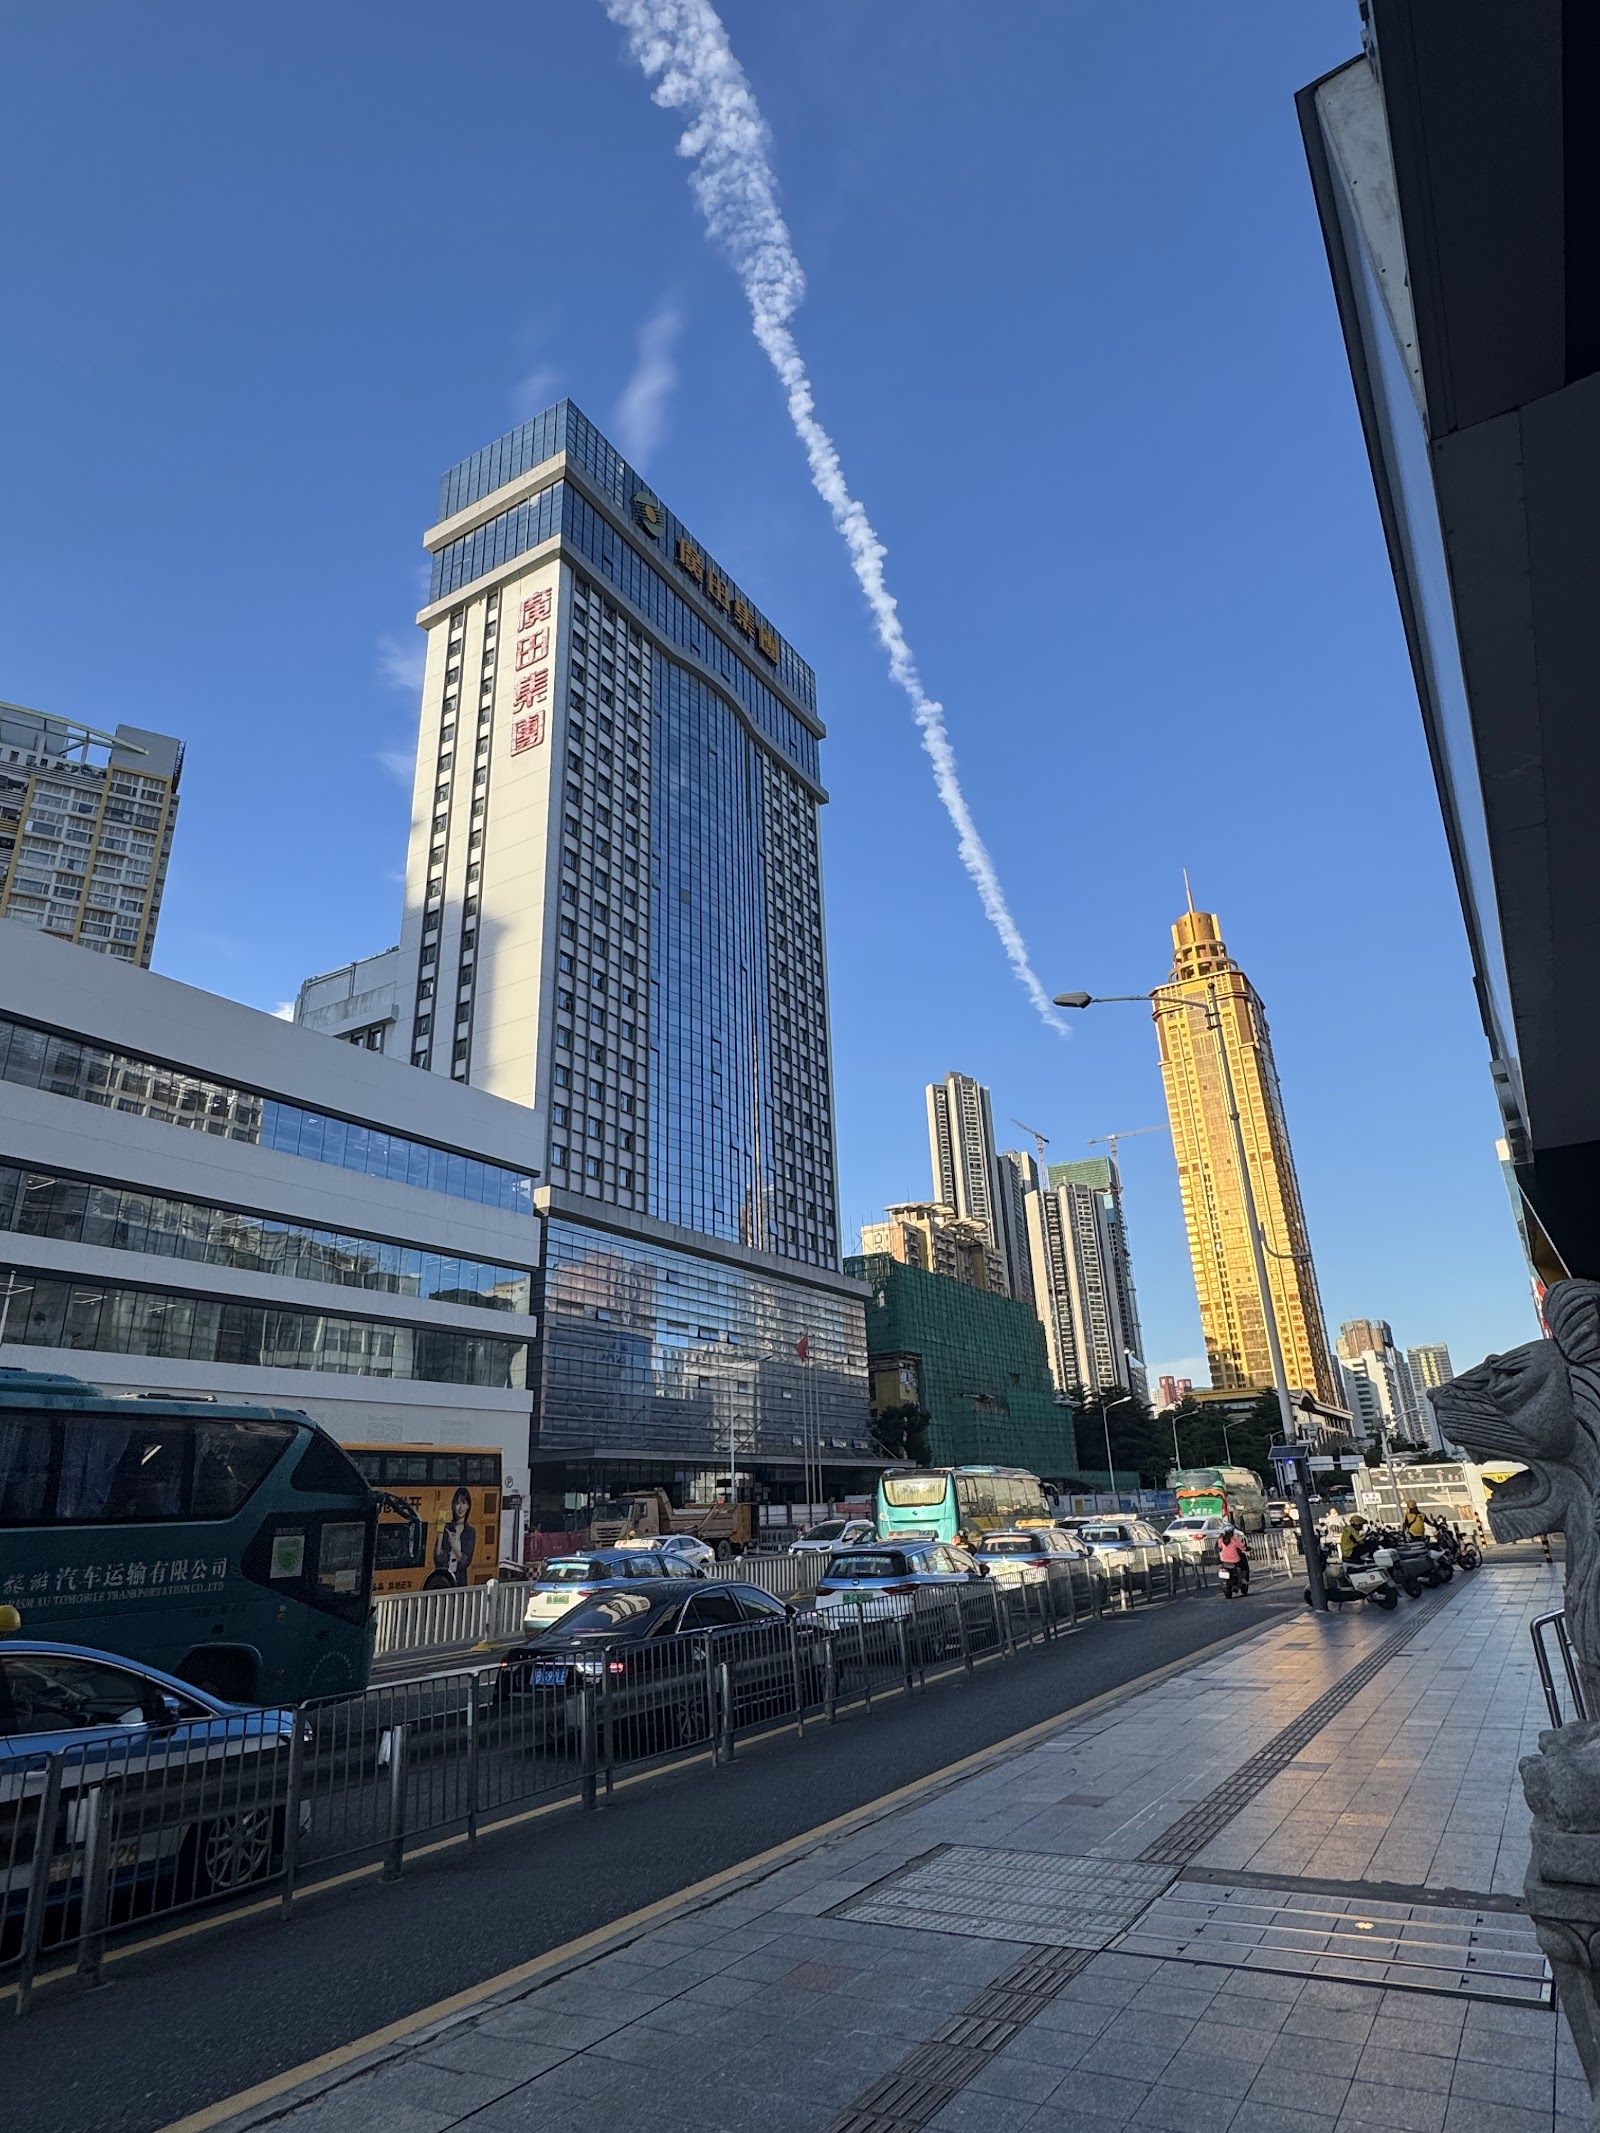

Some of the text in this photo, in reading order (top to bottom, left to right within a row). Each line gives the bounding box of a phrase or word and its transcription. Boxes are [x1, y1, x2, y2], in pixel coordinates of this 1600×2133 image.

[511, 588, 553, 757] 廣田集團
[676, 536, 778, 666] 廣田集團
